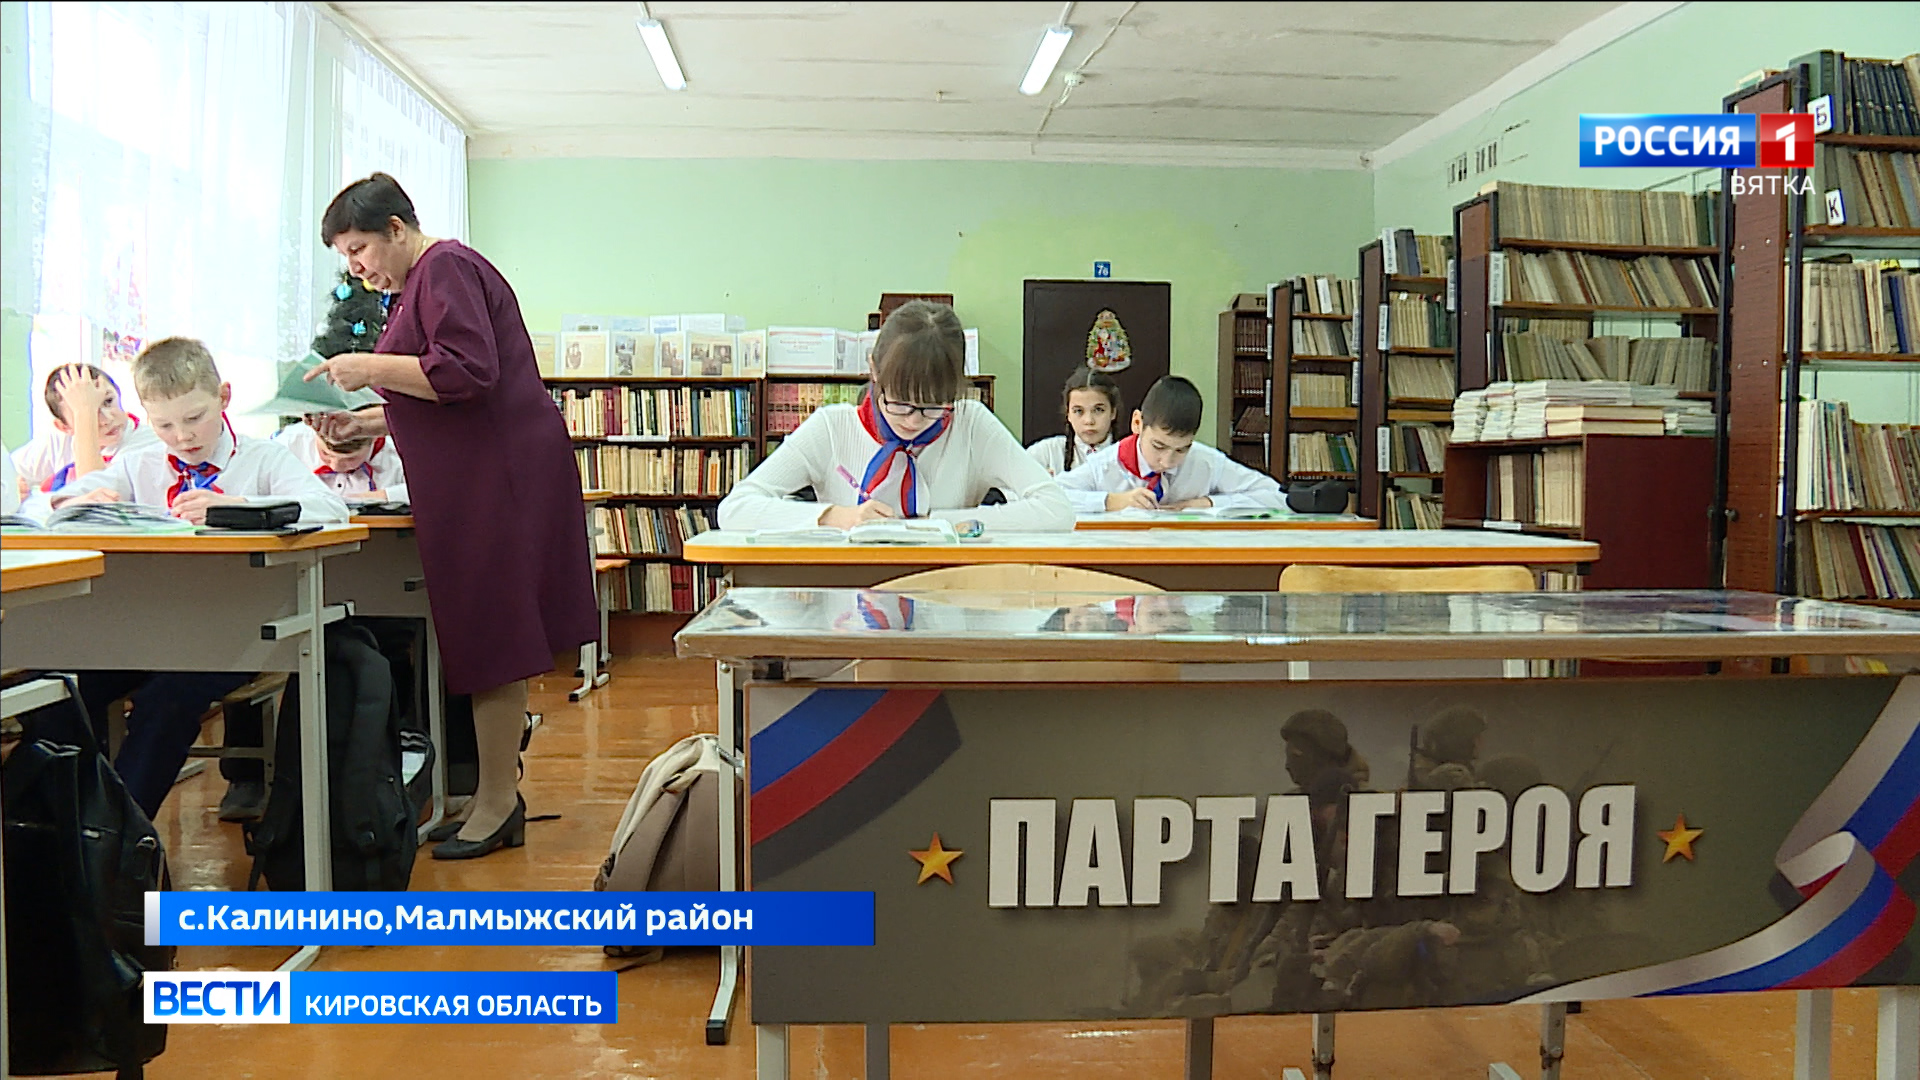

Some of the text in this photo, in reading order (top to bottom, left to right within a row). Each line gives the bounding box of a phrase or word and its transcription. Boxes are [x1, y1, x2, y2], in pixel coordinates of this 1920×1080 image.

[1815, 103, 1828, 126] Б
[1828, 196, 1840, 220] К
[988, 785, 1636, 908] ПАРТА ГЕРОЯ
